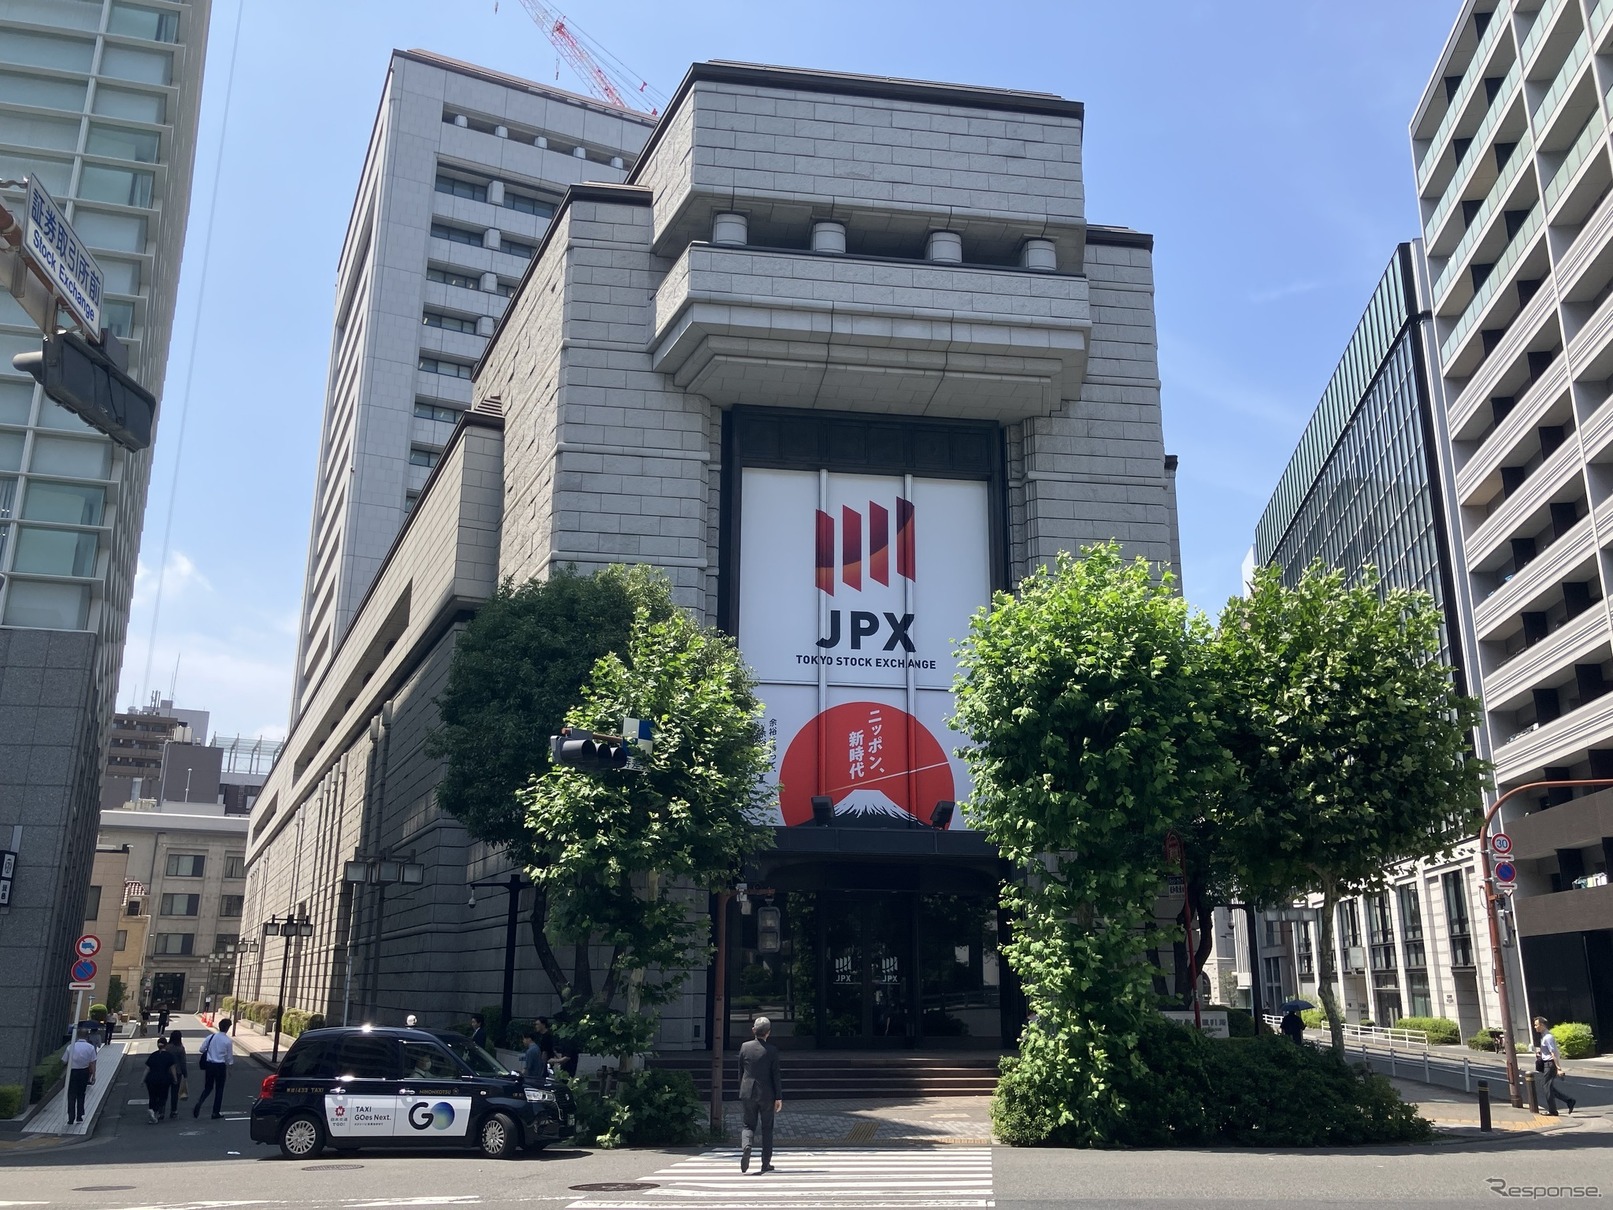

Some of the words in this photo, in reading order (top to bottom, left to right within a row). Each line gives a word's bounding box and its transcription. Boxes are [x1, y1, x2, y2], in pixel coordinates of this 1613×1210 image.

[32, 190, 100, 307] 証券取引所前
[33, 229, 56, 273] Stock
[58, 266, 95, 322] Exchange
[815, 610, 916, 652] JPX
[796, 655, 833, 666] TOKYO
[836, 656, 873, 667] STOCK
[876, 658, 936, 669] EXCHANGE
[849, 729, 864, 780] 新時代
[868, 709, 885, 773] ニッポン、
[1496, 839, 1508, 849] 30
[836, 974, 851, 982] JPX
[882, 974, 898, 982] JPX
[409, 1102, 455, 1130] GO
